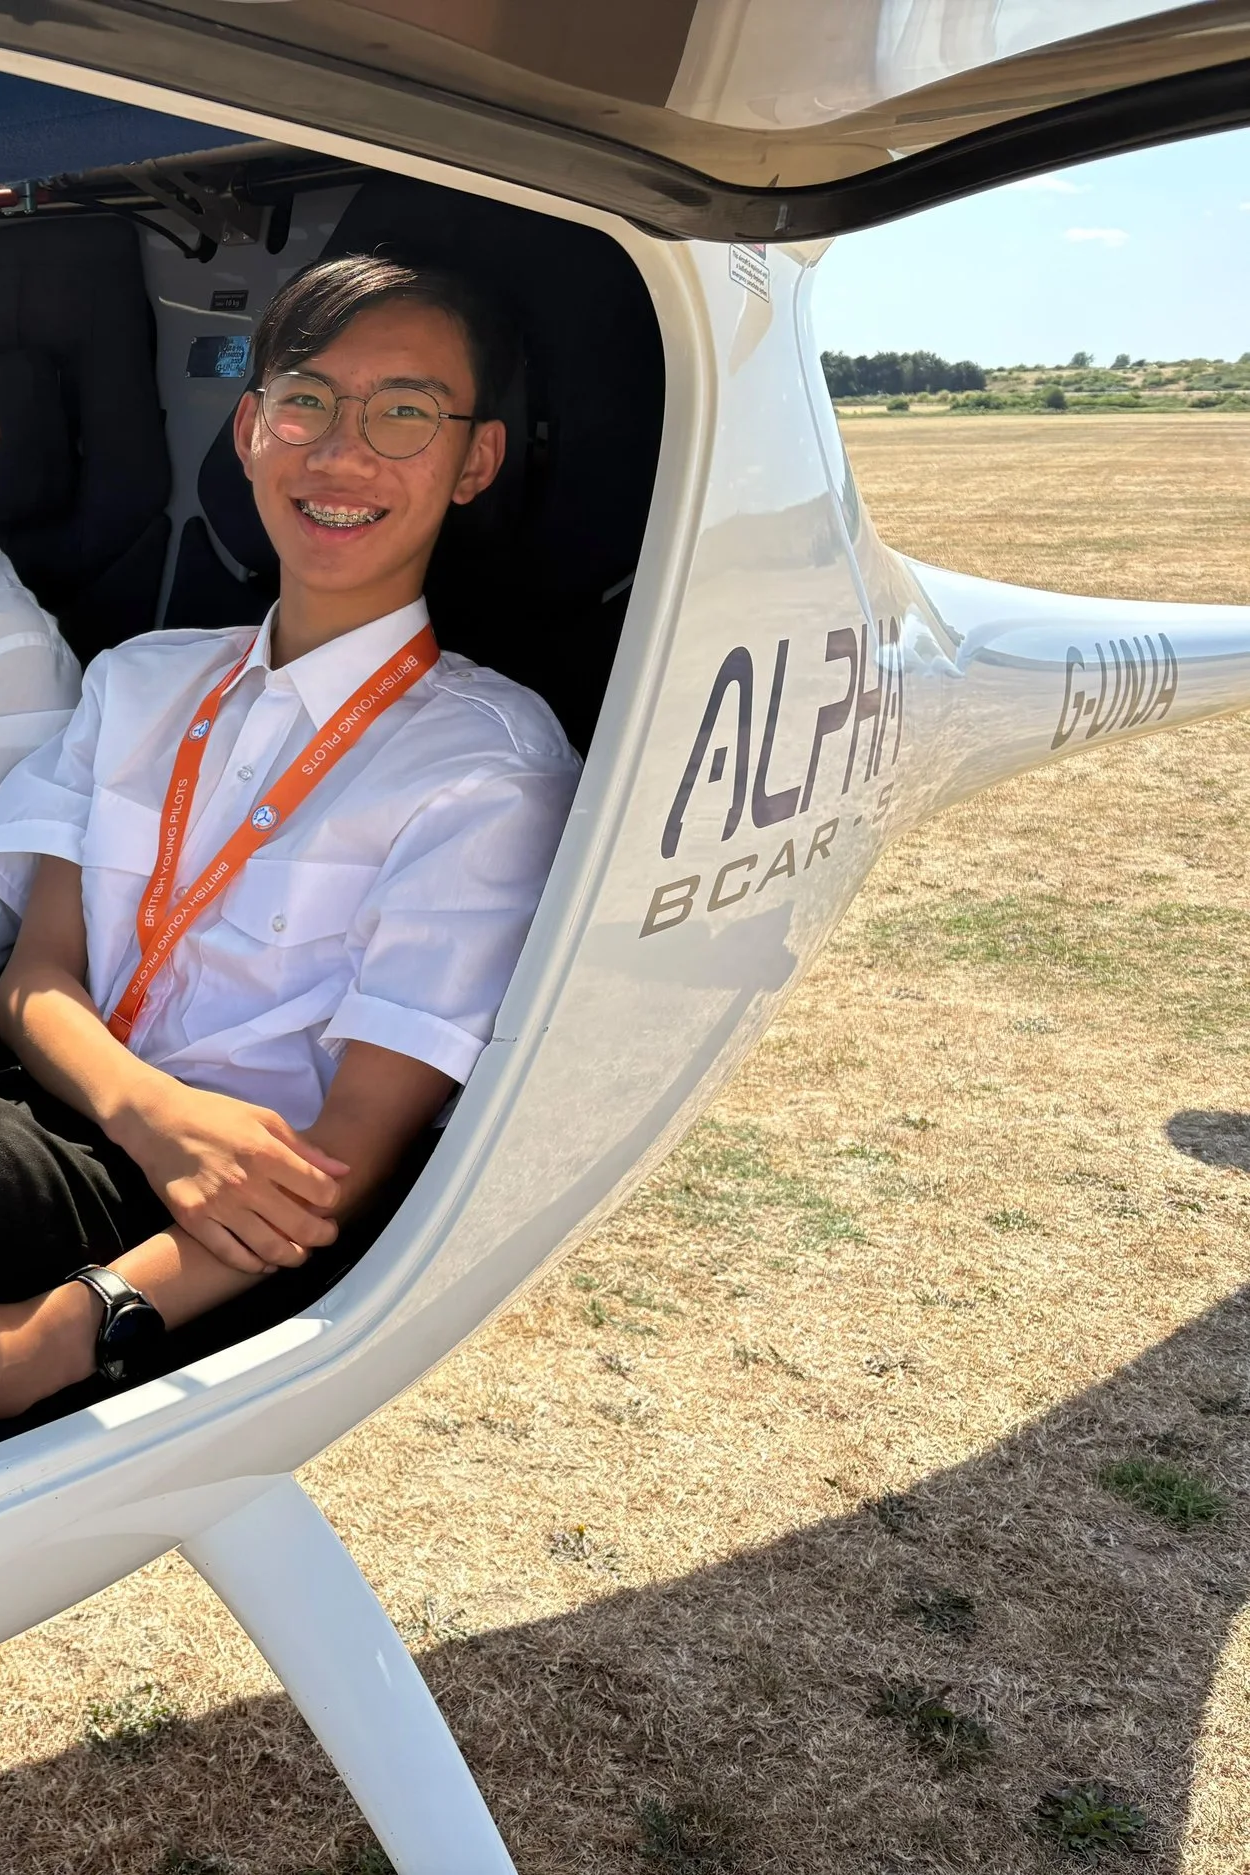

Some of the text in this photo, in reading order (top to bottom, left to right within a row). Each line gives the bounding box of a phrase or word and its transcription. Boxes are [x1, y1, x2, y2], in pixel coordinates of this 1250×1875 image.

[301, 654, 419, 775] BRITISH YOUNG PILOTS
[660, 616, 903, 859] ALPHA
[1050, 632, 1178, 750] G-UNJA
[144, 778, 188, 927] BRITISH YOUNG PILOTS
[131, 861, 230, 995] BRITISH YOUNG PILOTS
